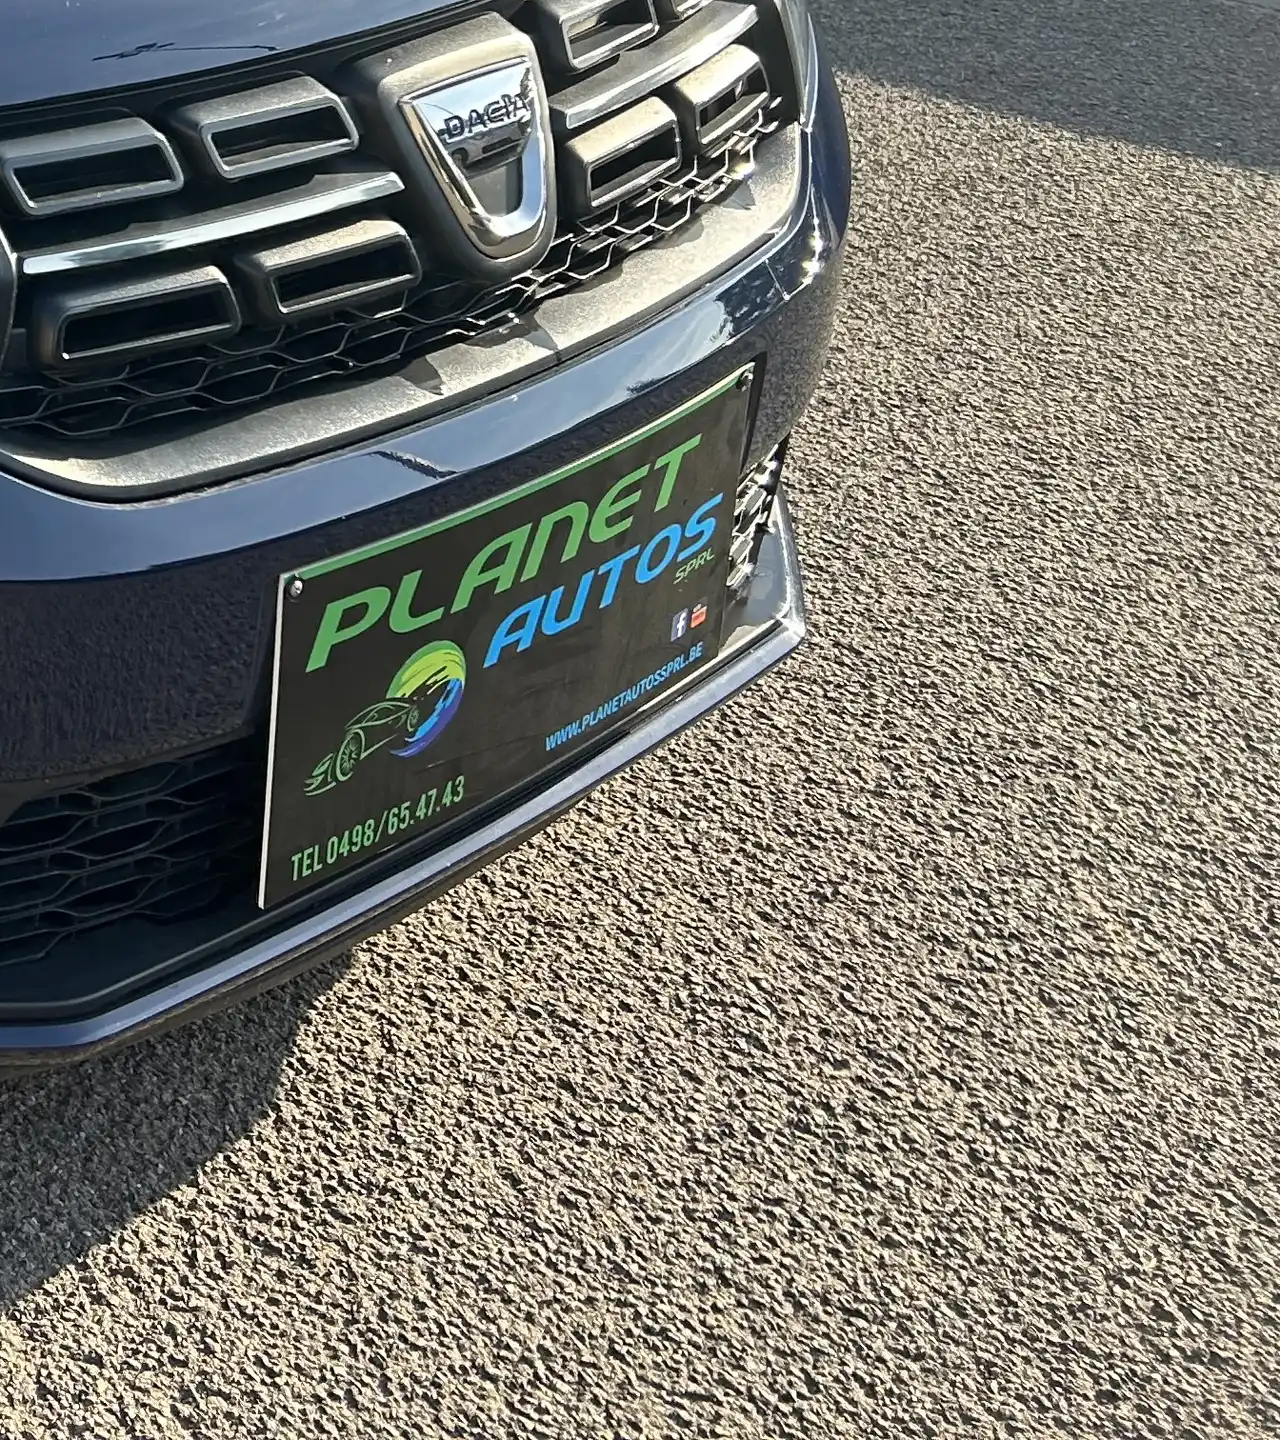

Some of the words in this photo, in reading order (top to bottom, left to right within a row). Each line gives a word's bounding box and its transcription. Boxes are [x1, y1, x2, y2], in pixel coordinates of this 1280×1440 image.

[443, 92, 530, 140] DACIA
[305, 433, 704, 673] PLANET
[483, 492, 724, 668] AUTOS
[673, 547, 716, 585] SPRL
[545, 641, 704, 752] WWW.PLANETAUTOSSPRL.BE
[291, 845, 323, 881] TEL
[326, 775, 466, 865] 0498/65.47.43
